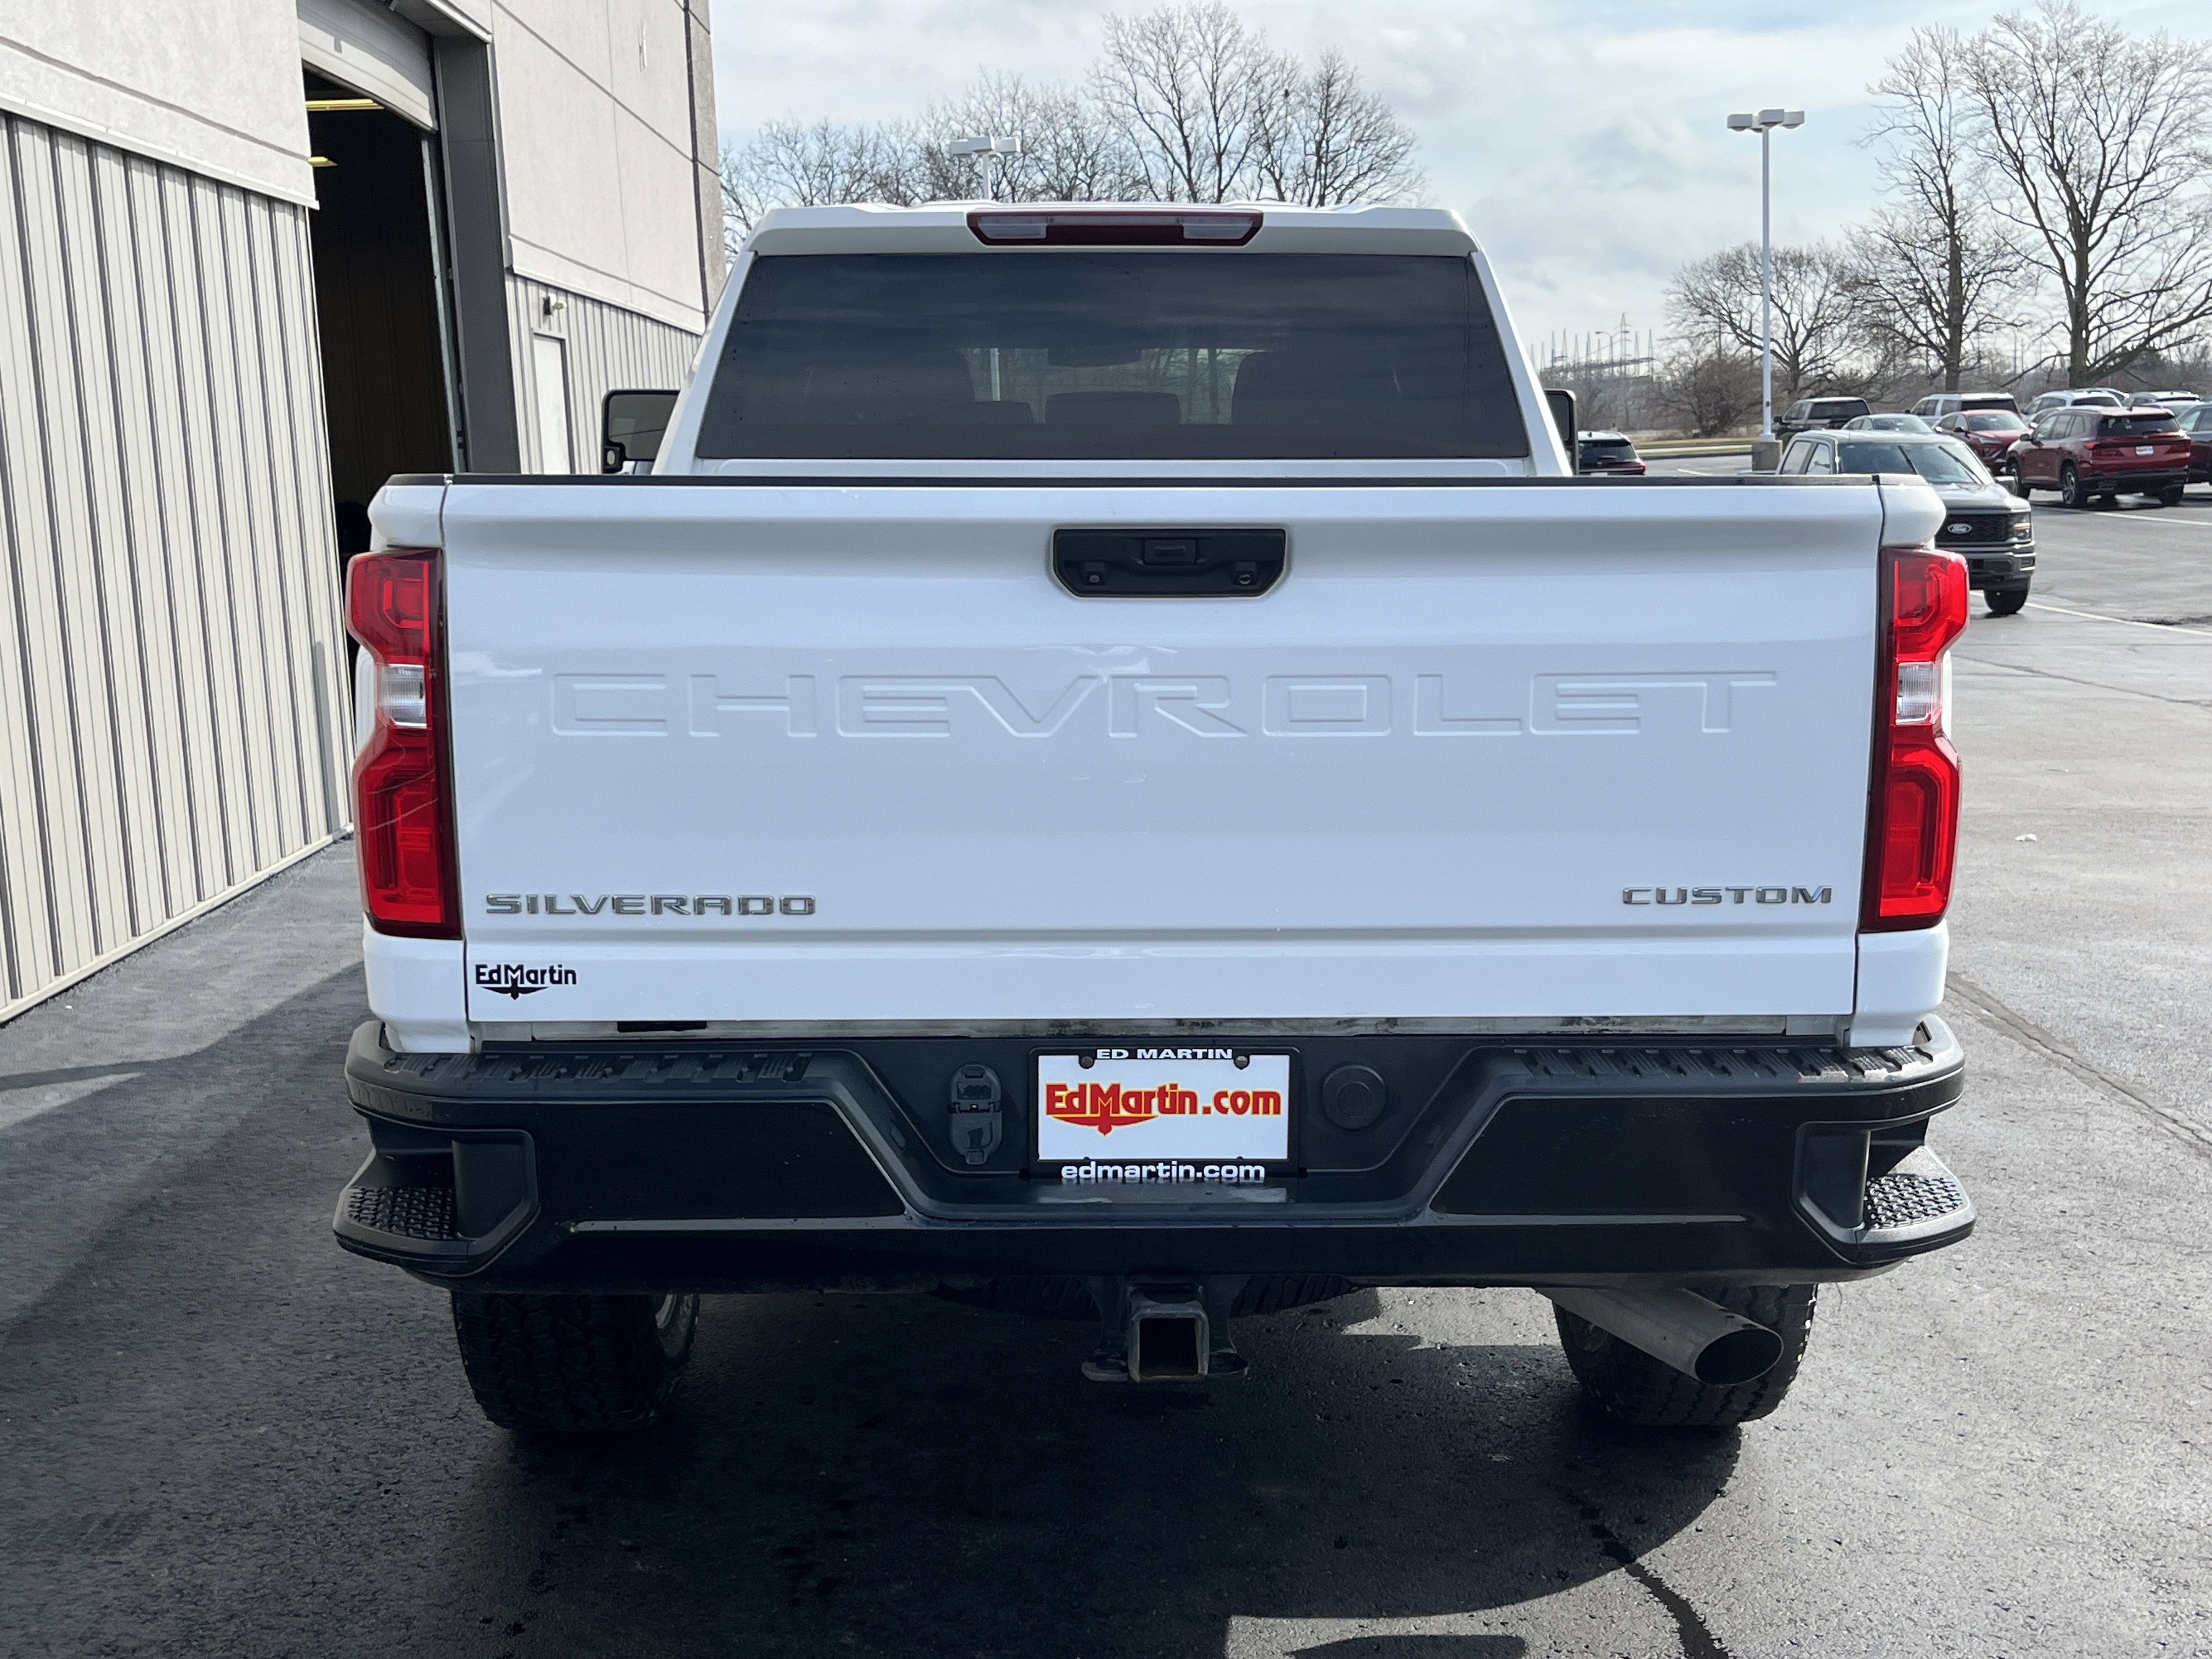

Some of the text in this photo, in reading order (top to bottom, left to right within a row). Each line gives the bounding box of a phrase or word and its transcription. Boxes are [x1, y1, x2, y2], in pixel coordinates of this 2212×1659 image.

[551, 671, 1778, 738] CHEVROLET
[486, 894, 816, 916] SILVERADO
[1623, 886, 1832, 905] CUSTOM
[1096, 1049, 1233, 1059] ED MARTIN
[1061, 1161, 1265, 1179] edmartin.com
